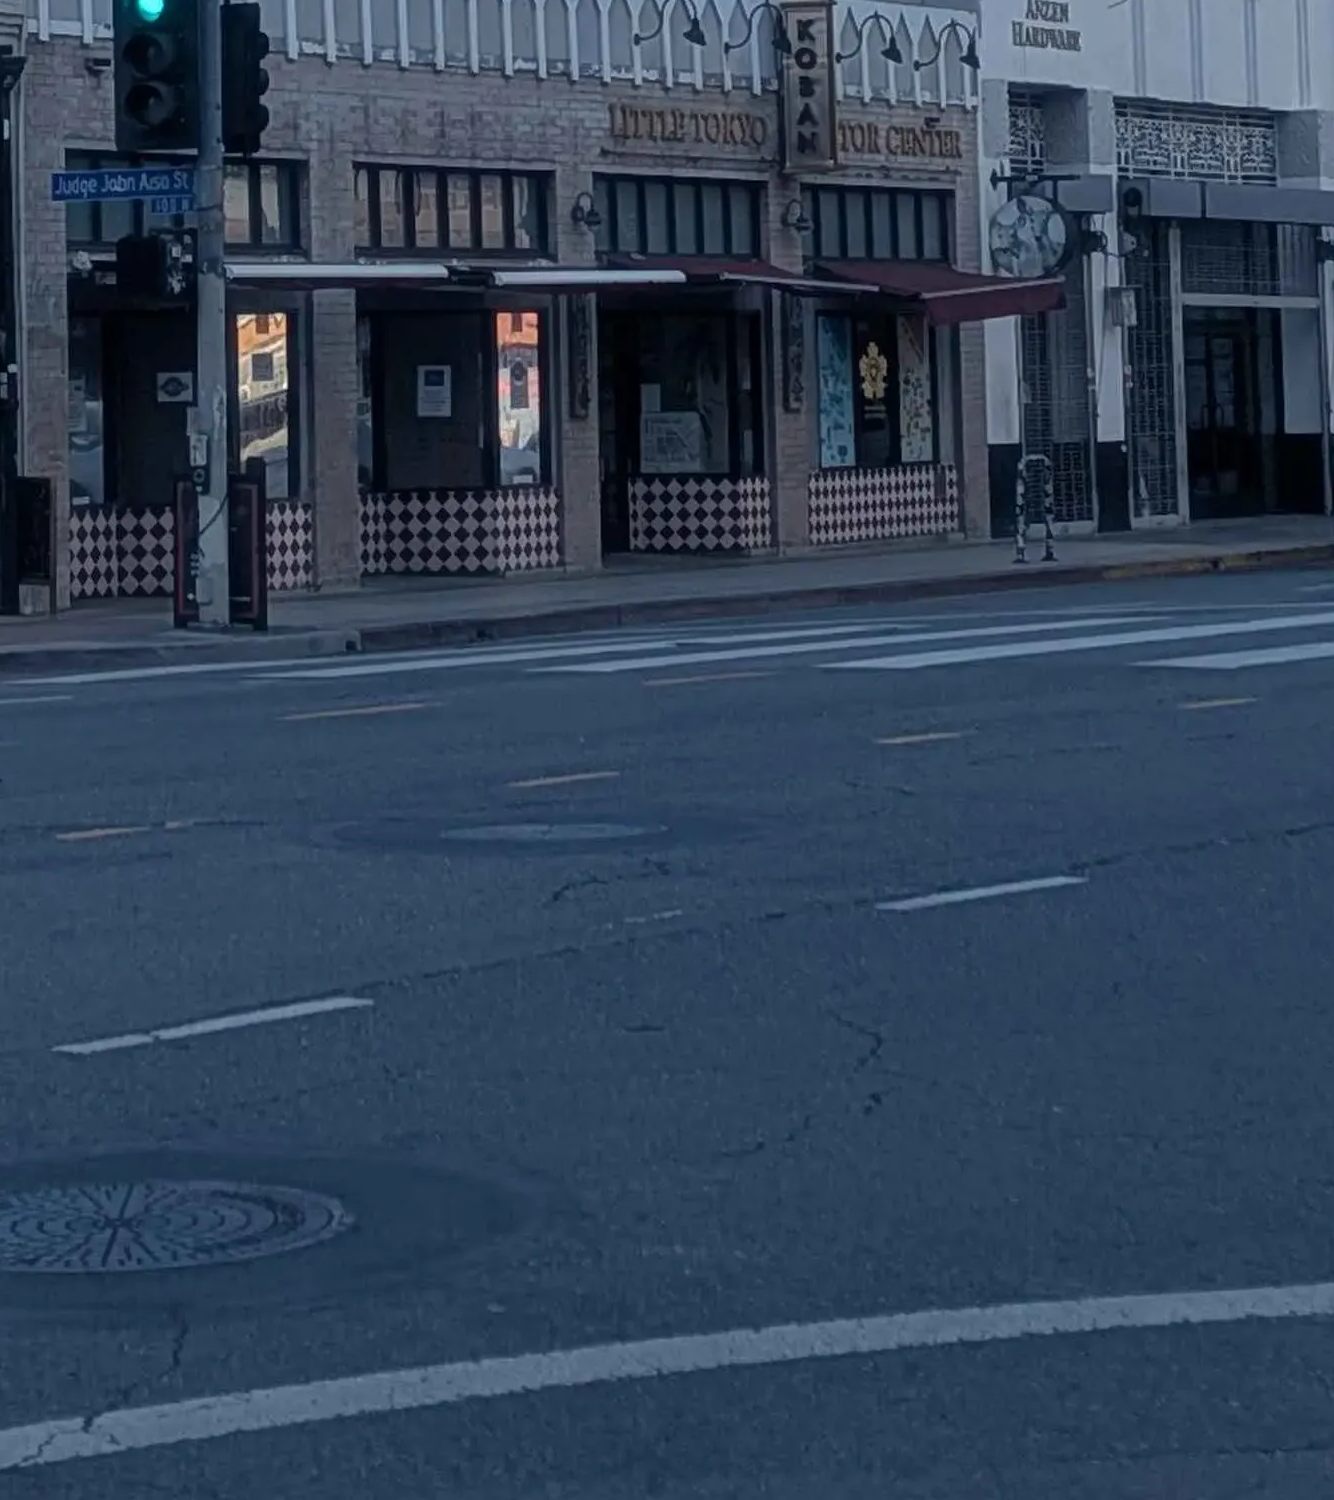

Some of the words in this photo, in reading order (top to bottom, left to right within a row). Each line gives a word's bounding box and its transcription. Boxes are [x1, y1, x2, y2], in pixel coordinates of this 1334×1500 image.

[1012, 20, 1081, 52] HARDWARE
[794, 19, 818, 154] KOBAN
[608, 104, 687, 142] LITTLE
[690, 111, 766, 147] TOKYO
[838, 122, 881, 153] TOR
[887, 126, 963, 158] CENTER
[54, 176, 97, 197] Judge
[101, 174, 135, 192] John
[173, 171, 189, 189] St
